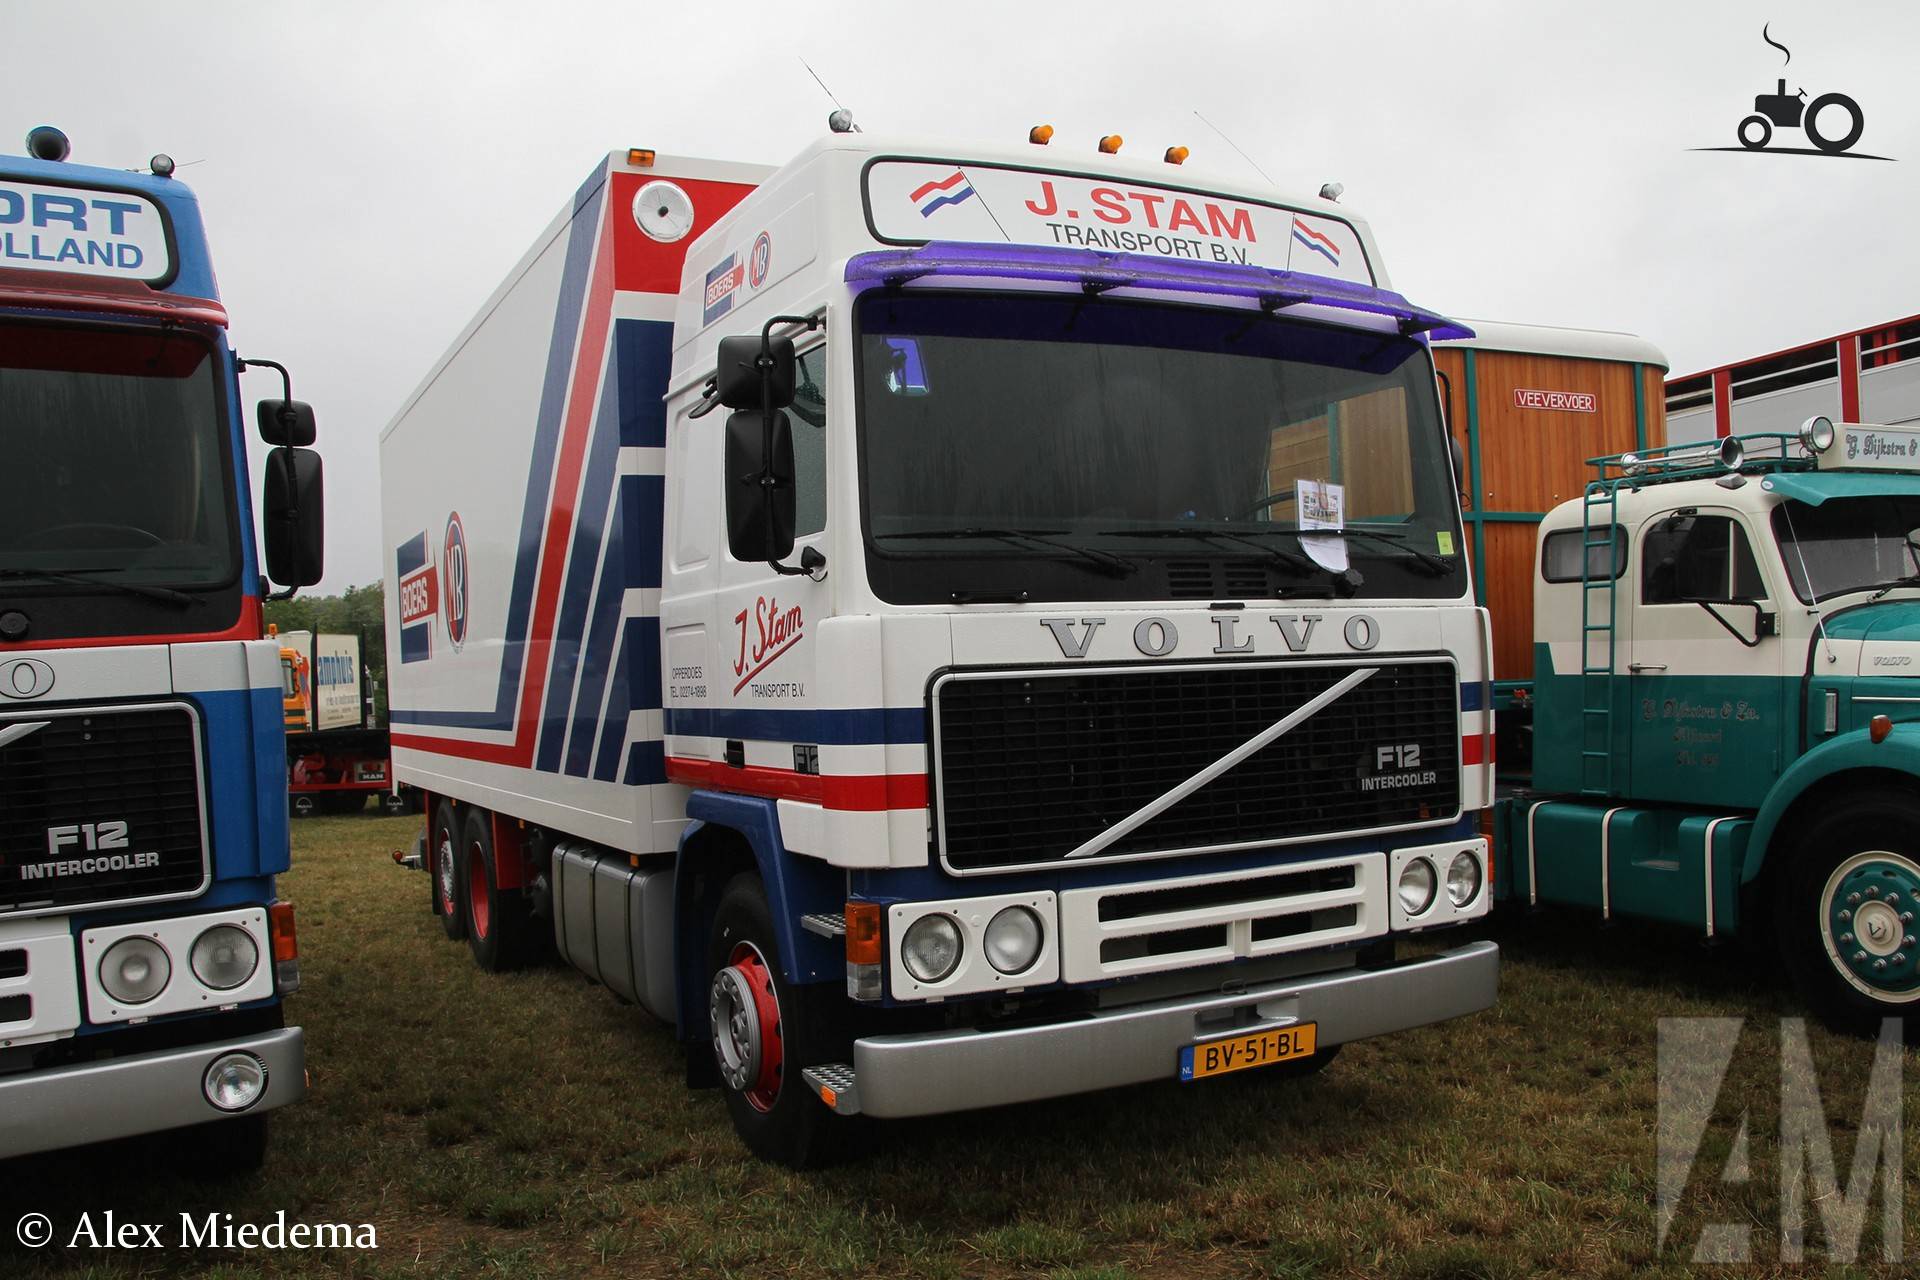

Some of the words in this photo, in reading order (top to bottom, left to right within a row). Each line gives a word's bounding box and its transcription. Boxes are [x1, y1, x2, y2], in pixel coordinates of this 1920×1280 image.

[1024, 181, 1079, 218] J.
[1090, 187, 1257, 243] STAM
[0, 231, 144, 269] LLAND
[1046, 223, 1202, 259] TRANSPORT
[1210, 243, 1253, 266] B.V.
[707, 272, 734, 305] BOERS
[1517, 391, 1593, 411] VEEVERVOER
[1863, 433, 1906, 460] Dijkstra
[402, 576, 428, 618] BOERS
[753, 596, 804, 663] Stam
[1040, 614, 1381, 658] VOLVO
[672, 666, 703, 680] OPPERDOES
[1872, 655, 1913, 666] VOLVO
[751, 683, 790, 698] TRANSPORT
[791, 683, 806, 698] B.V.
[1377, 744, 1420, 770] F12
[1361, 771, 1436, 791] INTERCOOLER
[48, 820, 129, 855] F12
[21, 852, 159, 880] INTERCOOLER
[1206, 1031, 1304, 1071] BV-51-BL
[1182, 1066, 1192, 1074] NL
